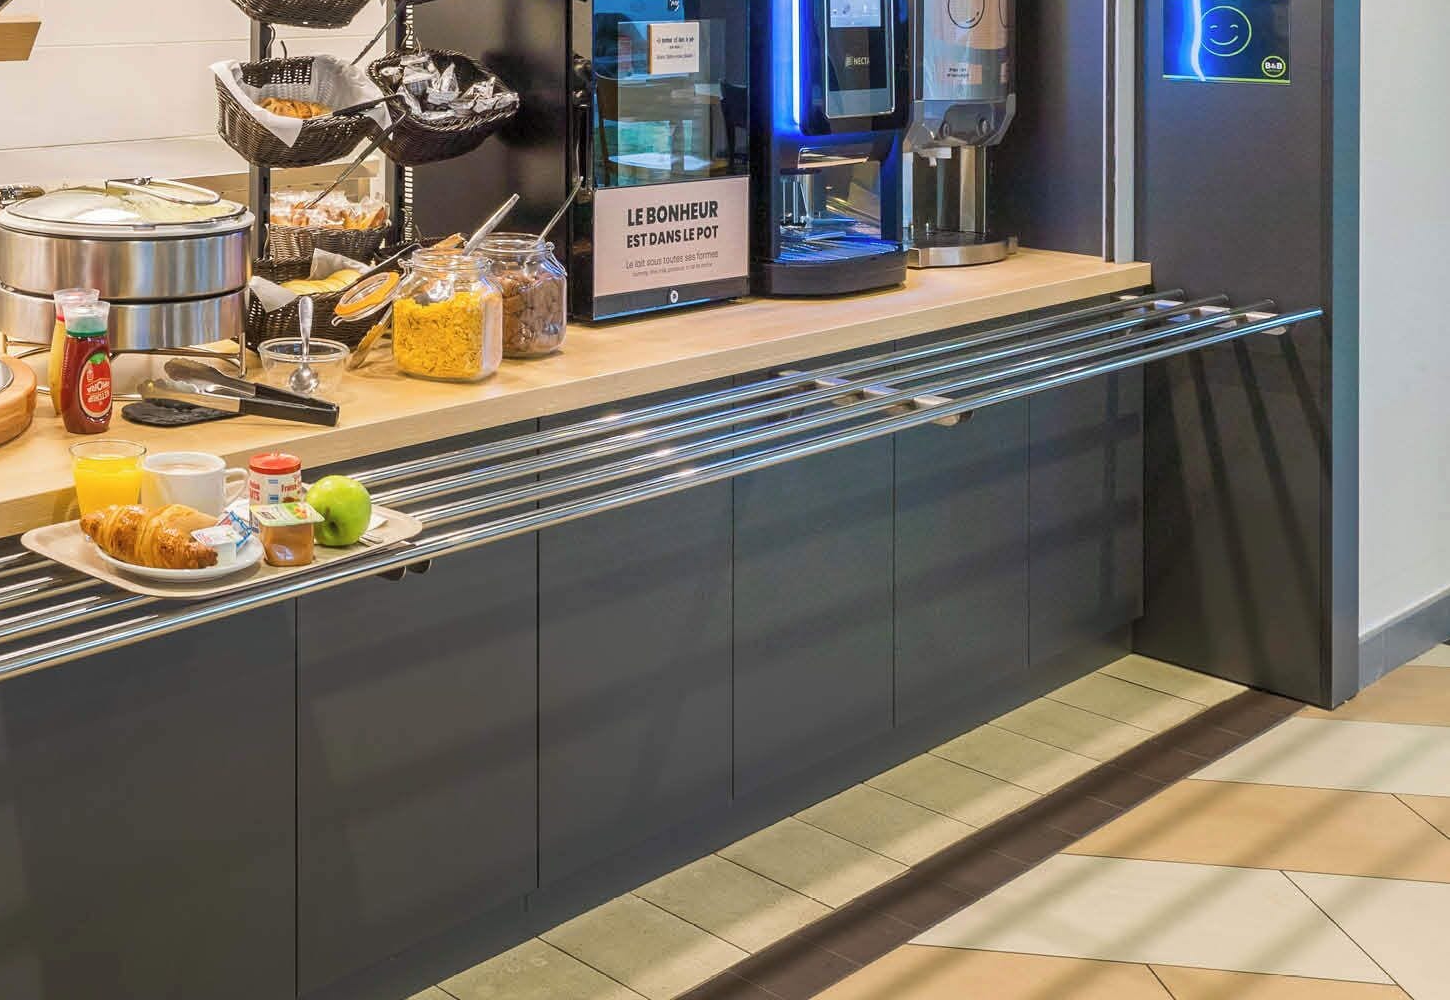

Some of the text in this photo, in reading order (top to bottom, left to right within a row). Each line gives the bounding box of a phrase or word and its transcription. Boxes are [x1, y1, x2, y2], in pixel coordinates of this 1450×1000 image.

[627, 200, 719, 227] LE BONHEUR
[626, 225, 719, 248] EST DANS LE POT
